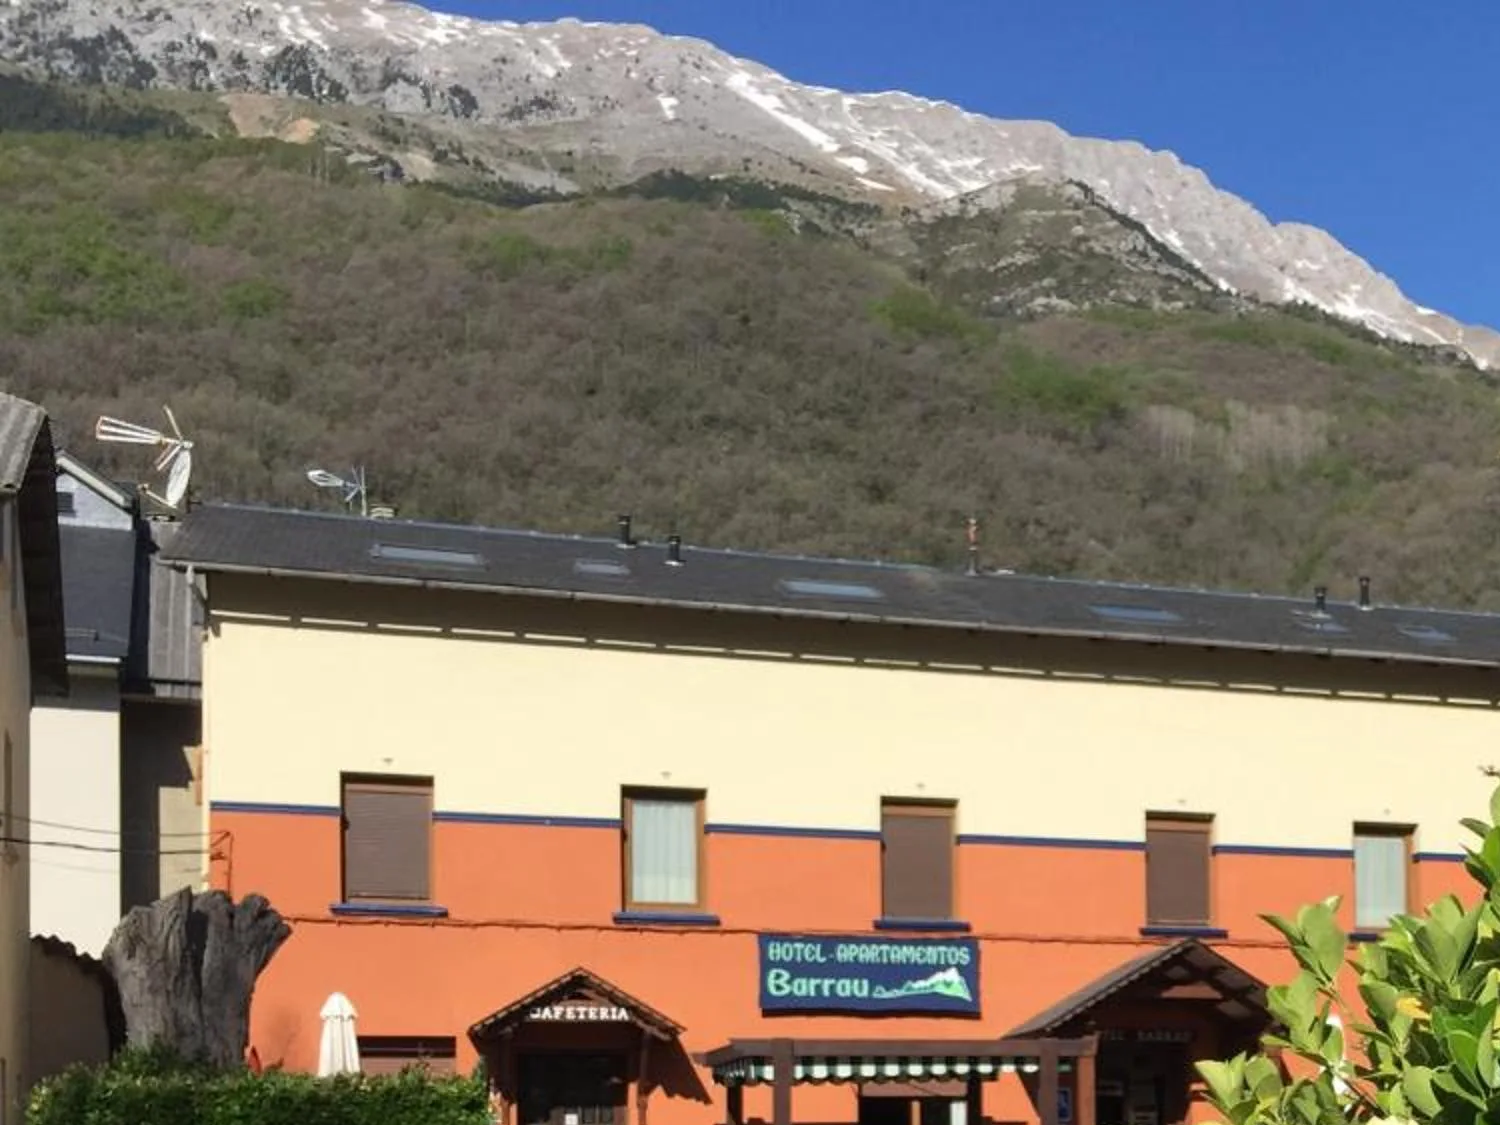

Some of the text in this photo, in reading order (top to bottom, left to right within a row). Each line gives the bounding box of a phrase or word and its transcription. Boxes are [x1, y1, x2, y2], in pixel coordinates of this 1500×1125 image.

[768, 941, 826, 964] HOTEL
[835, 943, 970, 966] APARTAMENTOS
[767, 968, 869, 998] Barrau
